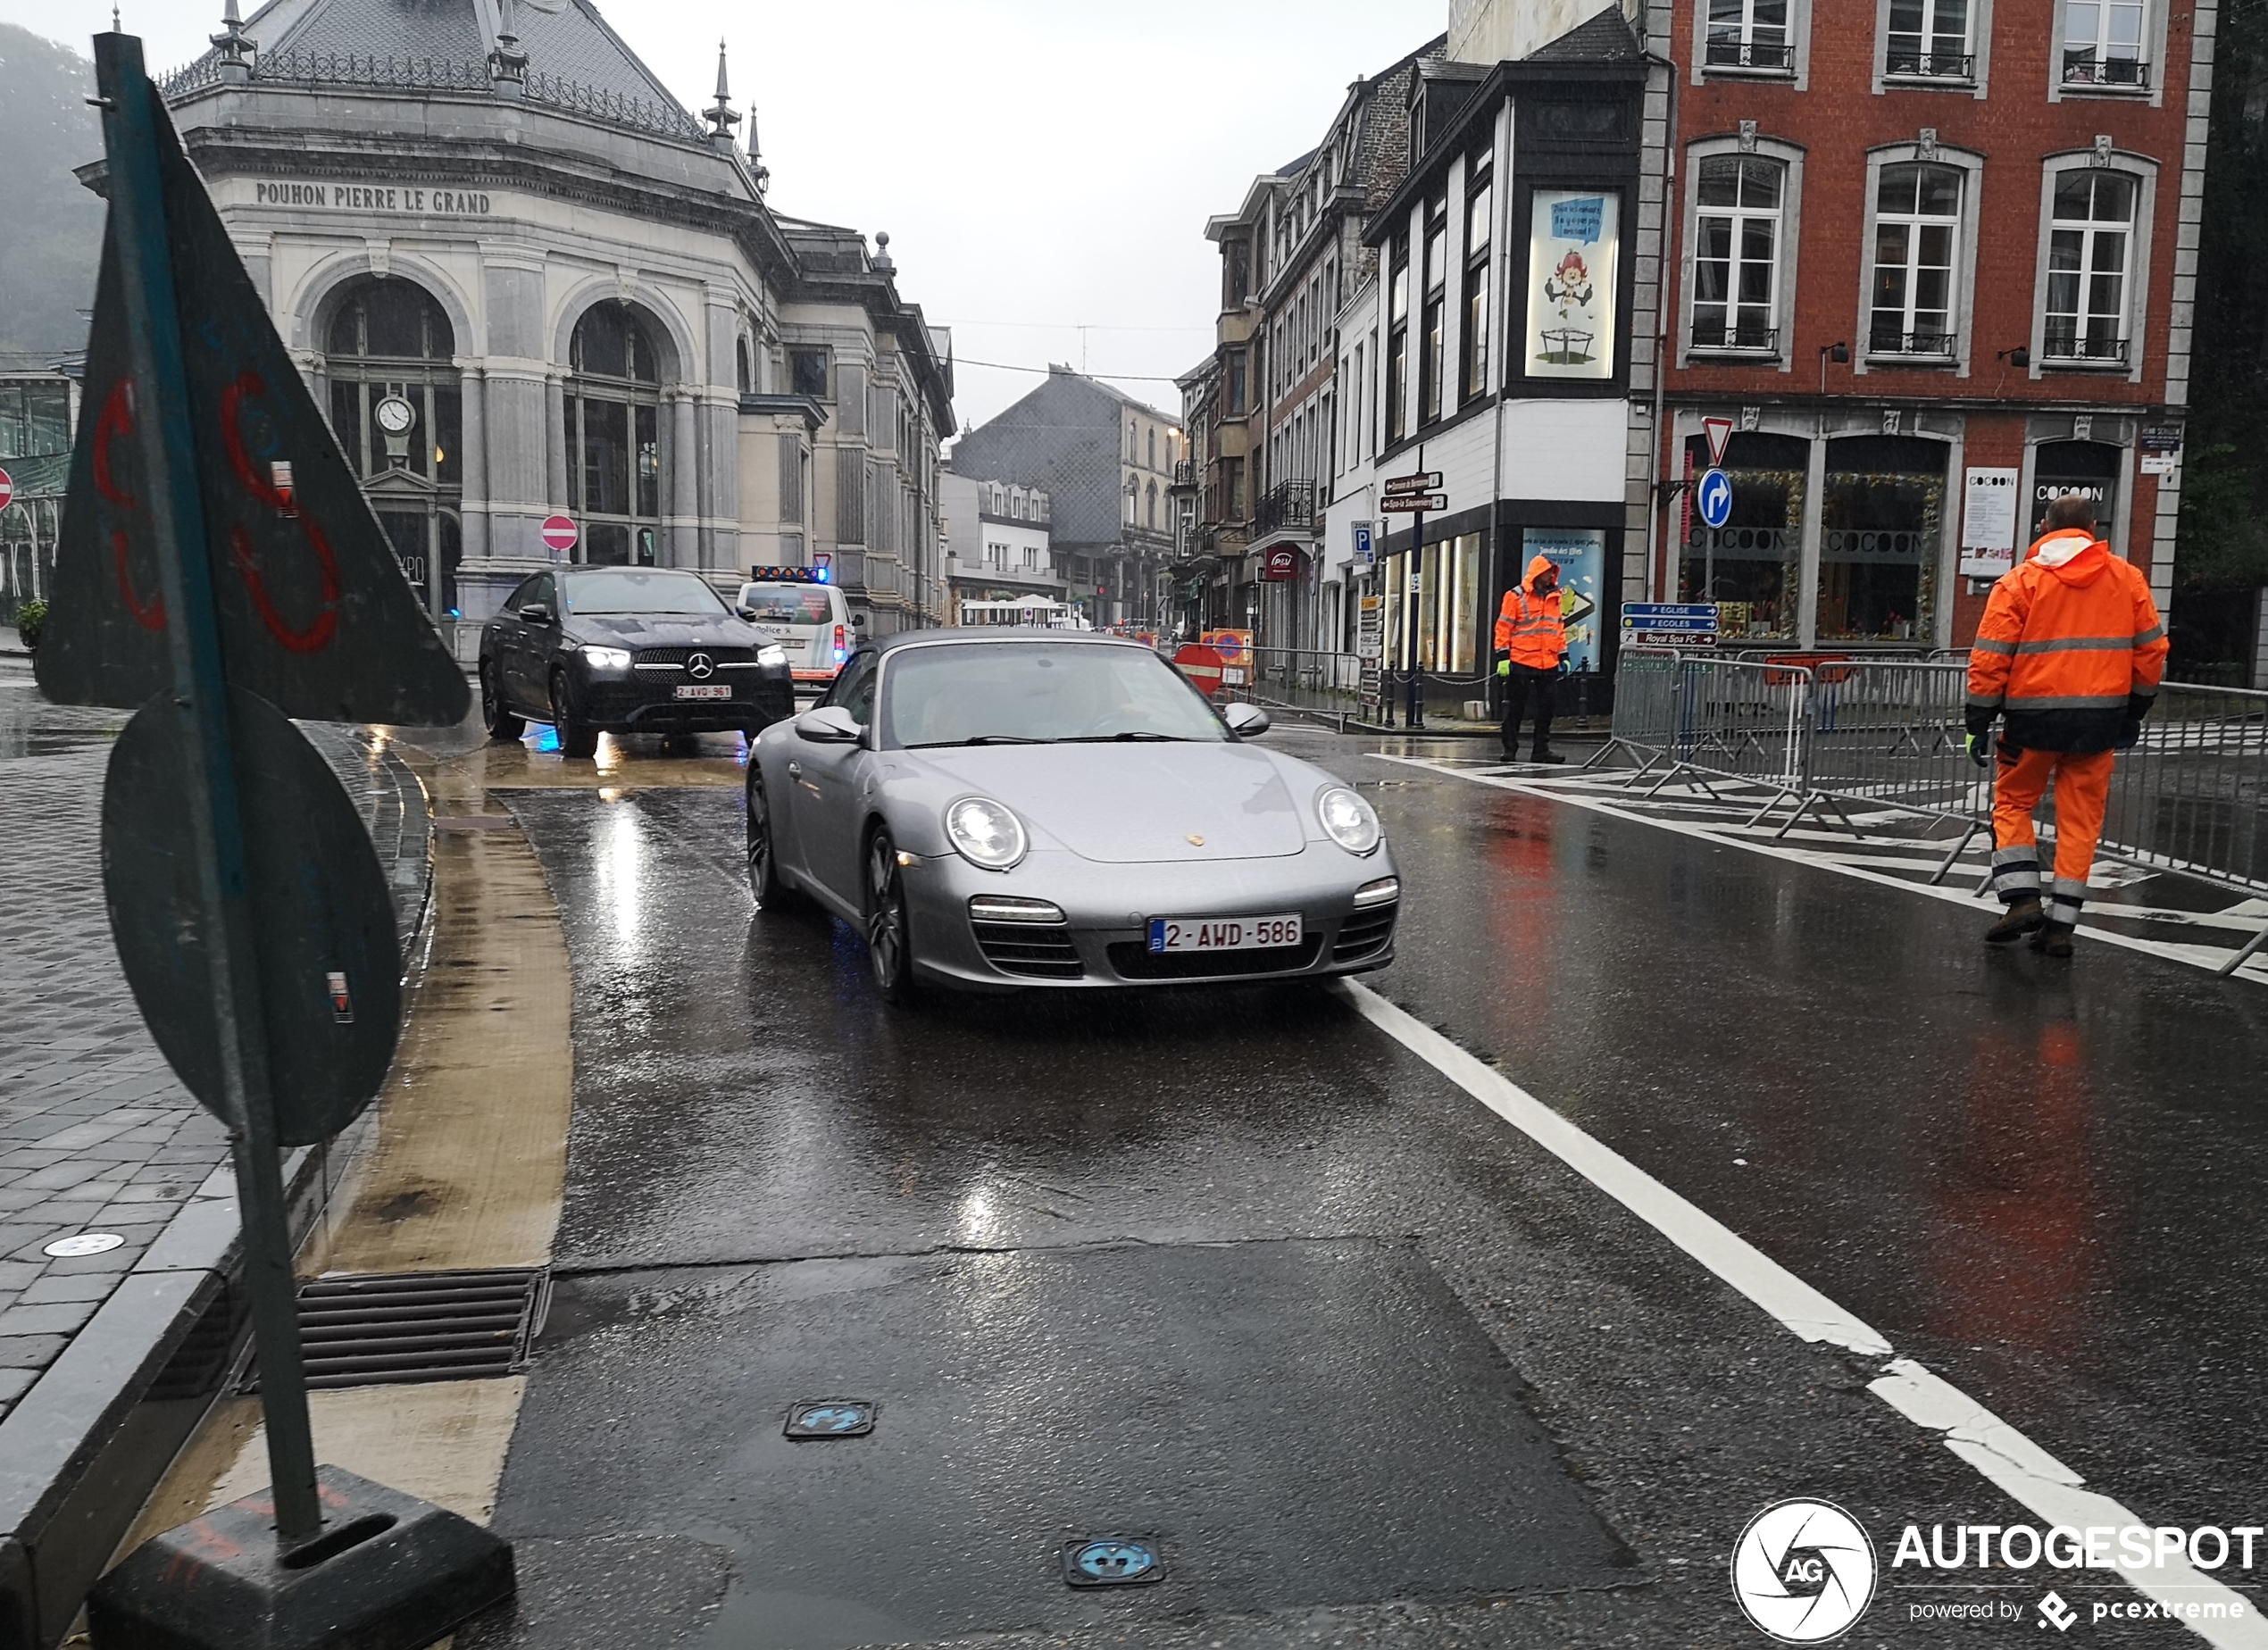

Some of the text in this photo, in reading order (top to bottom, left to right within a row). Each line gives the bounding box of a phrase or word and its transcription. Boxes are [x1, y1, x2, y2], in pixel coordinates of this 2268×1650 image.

[256, 182, 490, 213] POUHON PIERRE LE GRAND
[1969, 476, 2014, 487] COCOON
[2037, 486, 2103, 502] COCOON
[1357, 531, 1367, 549] P
[1274, 558, 1291, 566] P&V
[1660, 606, 1689, 614] EGLISE
[1657, 620, 1690, 628] ECOLES
[1646, 633, 1697, 644] Royal Spa FC
[1166, 921, 1298, 946] 2-AWD-586
[1152, 938, 1163, 948] B
